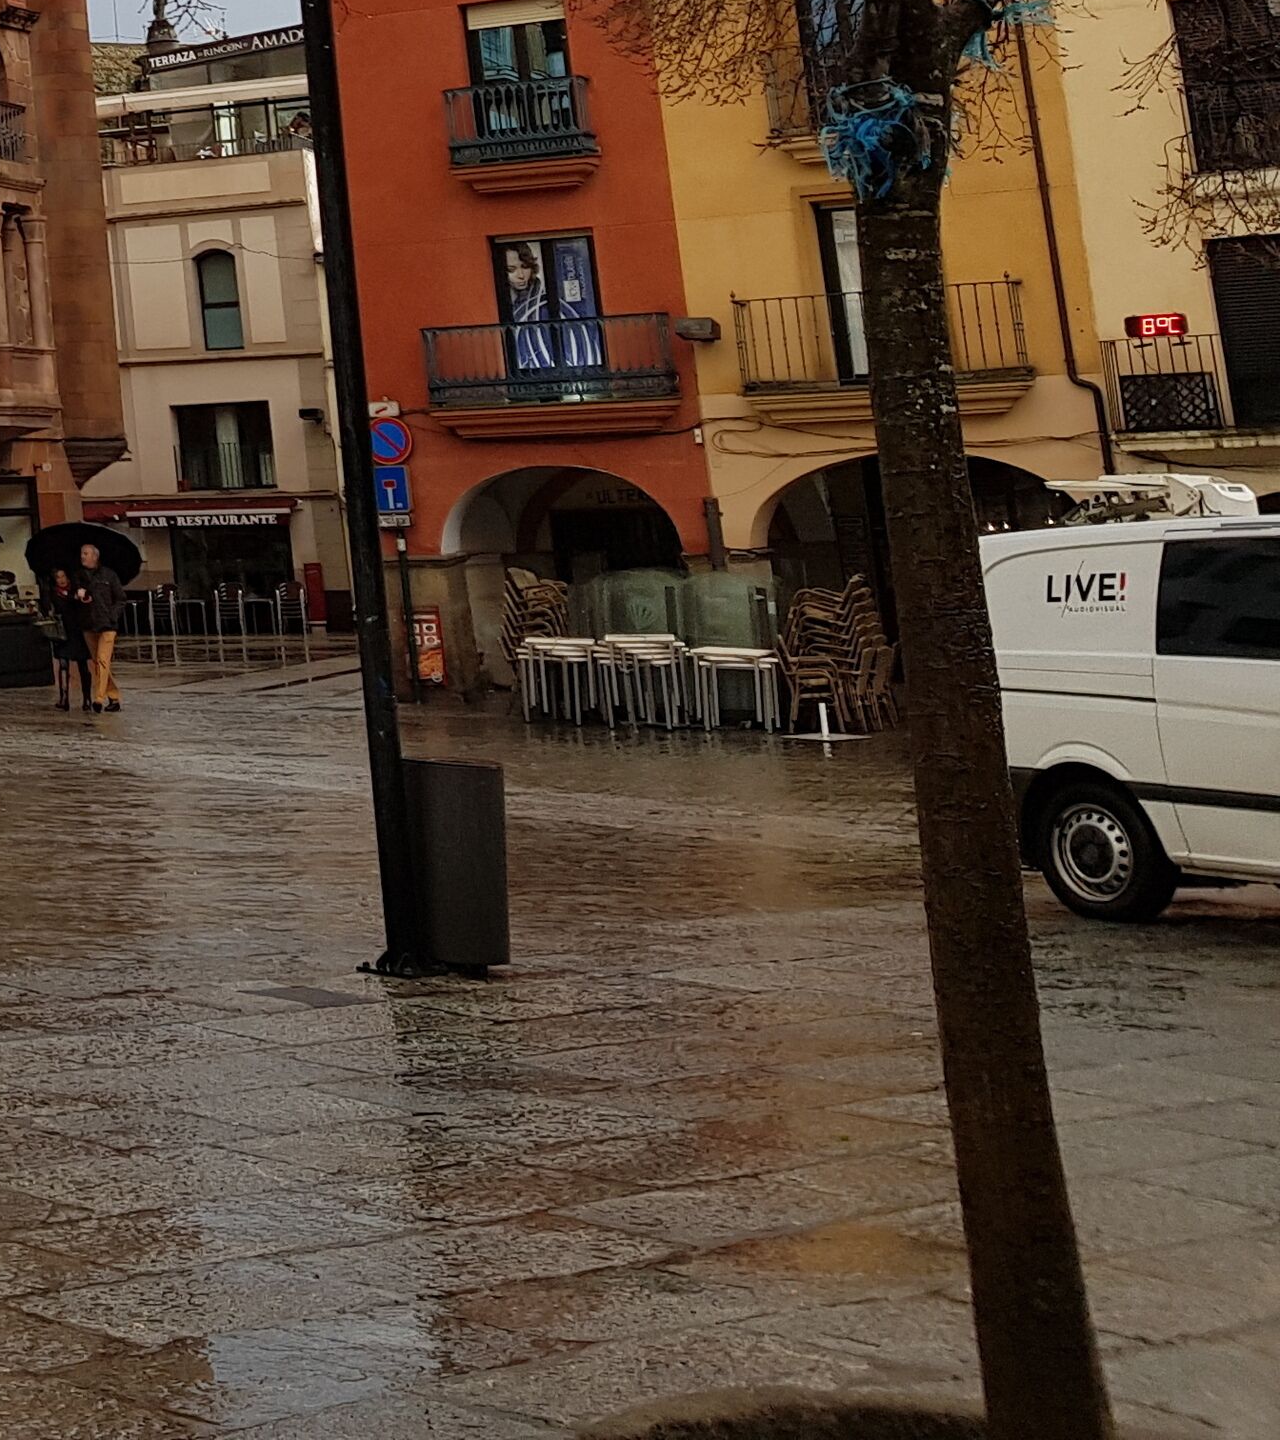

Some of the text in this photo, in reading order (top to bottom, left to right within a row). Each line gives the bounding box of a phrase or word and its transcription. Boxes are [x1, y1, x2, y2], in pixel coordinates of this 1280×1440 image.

[149, 50, 197, 68] TERRAZA
[140, 517, 168, 528] BAR
[176, 514, 278, 527] RESTAURANTE
[1046, 572, 1126, 603] LIVE!
